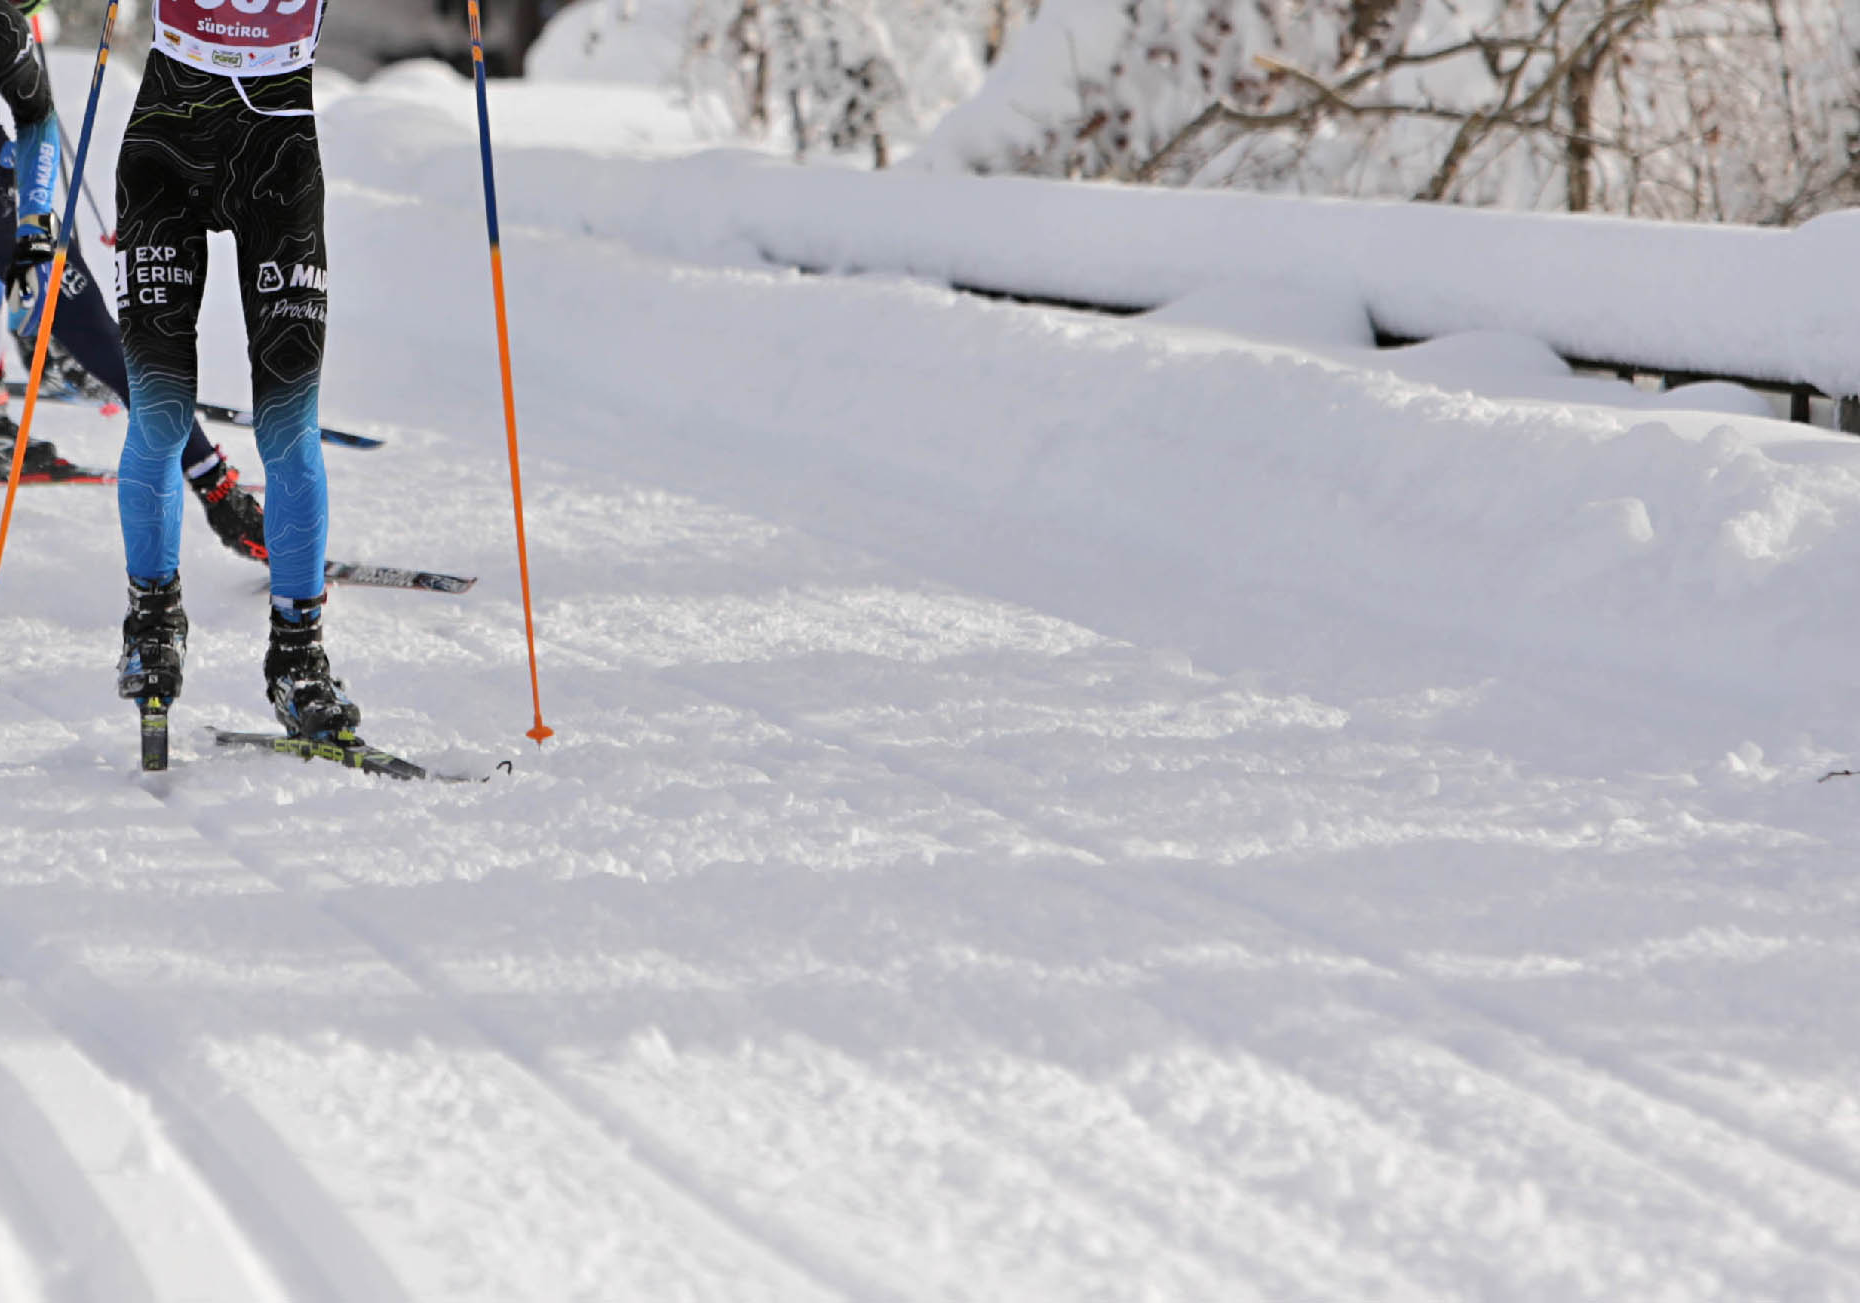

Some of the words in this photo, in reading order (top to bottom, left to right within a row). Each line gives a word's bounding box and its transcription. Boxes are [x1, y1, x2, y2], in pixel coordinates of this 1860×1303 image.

[135, 247, 176, 262] EXP
[136, 266, 193, 286] ERIEN
[139, 287, 168, 304] CE
